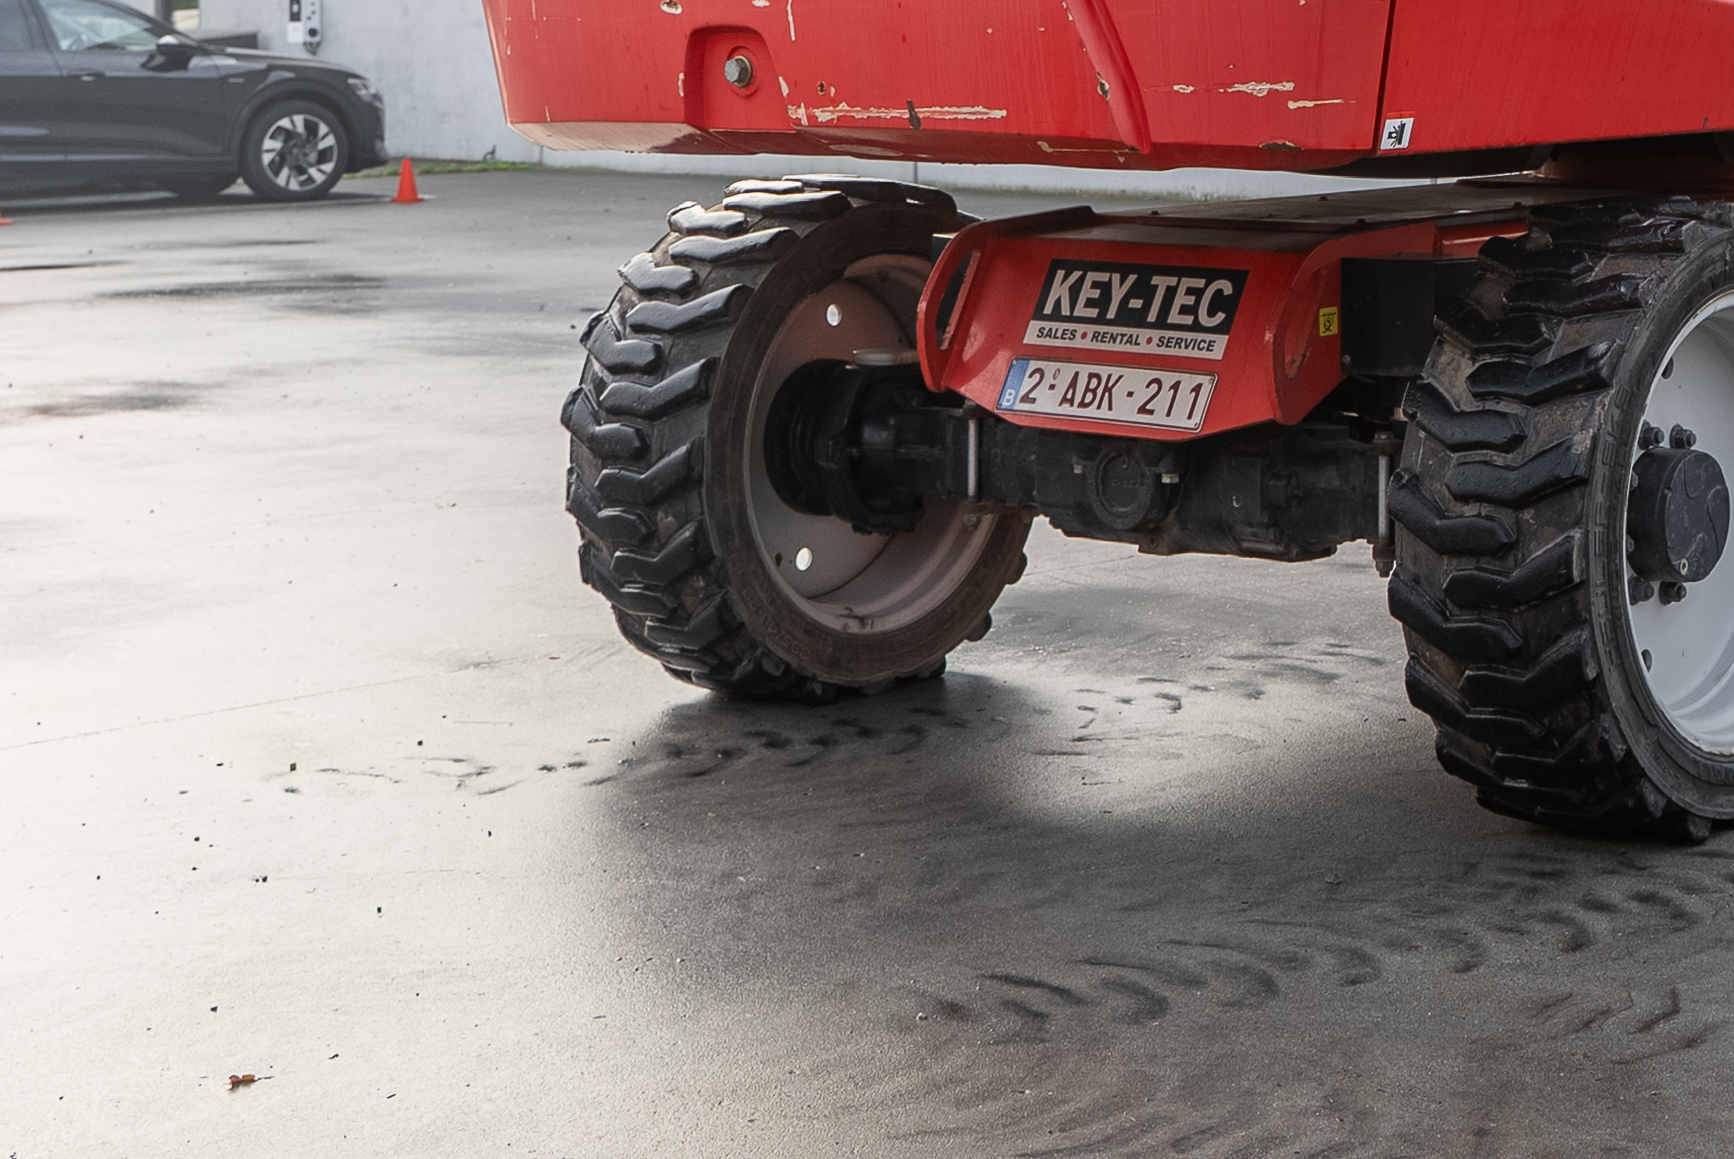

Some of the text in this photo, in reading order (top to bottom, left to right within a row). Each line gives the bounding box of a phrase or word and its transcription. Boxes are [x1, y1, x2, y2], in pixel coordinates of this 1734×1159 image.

[1043, 269, 1233, 328] KEY-TEC
[1036, 326, 1216, 352] SALES RENTAL SERVICE
[1002, 389, 1014, 407] B
